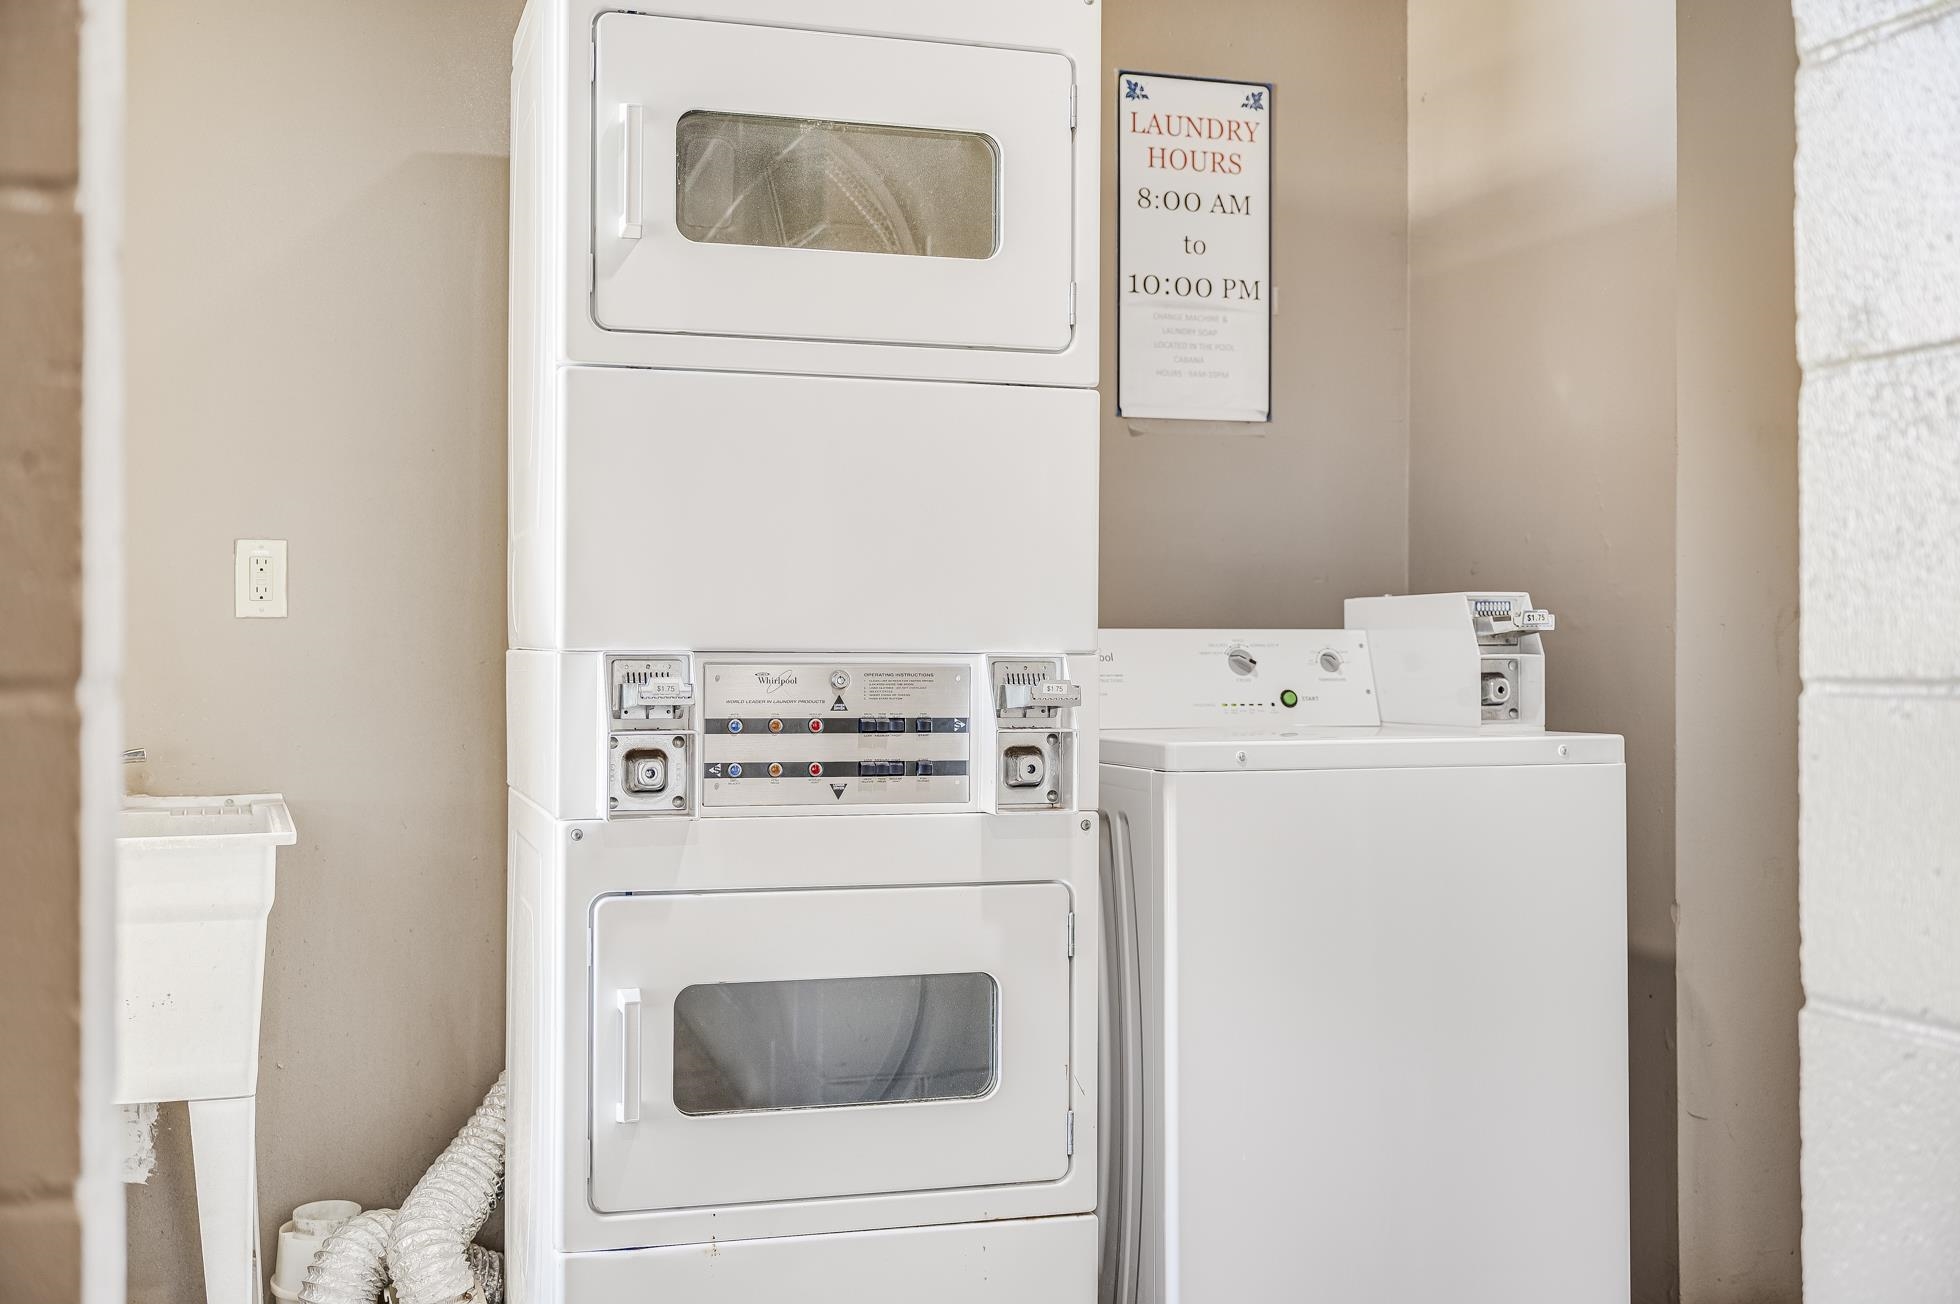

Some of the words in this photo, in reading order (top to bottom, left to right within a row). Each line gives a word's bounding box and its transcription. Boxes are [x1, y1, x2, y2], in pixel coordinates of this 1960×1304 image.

[1130, 111, 1260, 143] LAUNDRY
[1147, 146, 1243, 175] HOURS
[1137, 186, 1202, 213] 8:00
[1210, 194, 1251, 216] AM
[1184, 235, 1207, 256] to
[1128, 273, 1213, 299] 10:00
[1223, 278, 1261, 301] PM
[757, 676, 797, 687] Whirlpool
